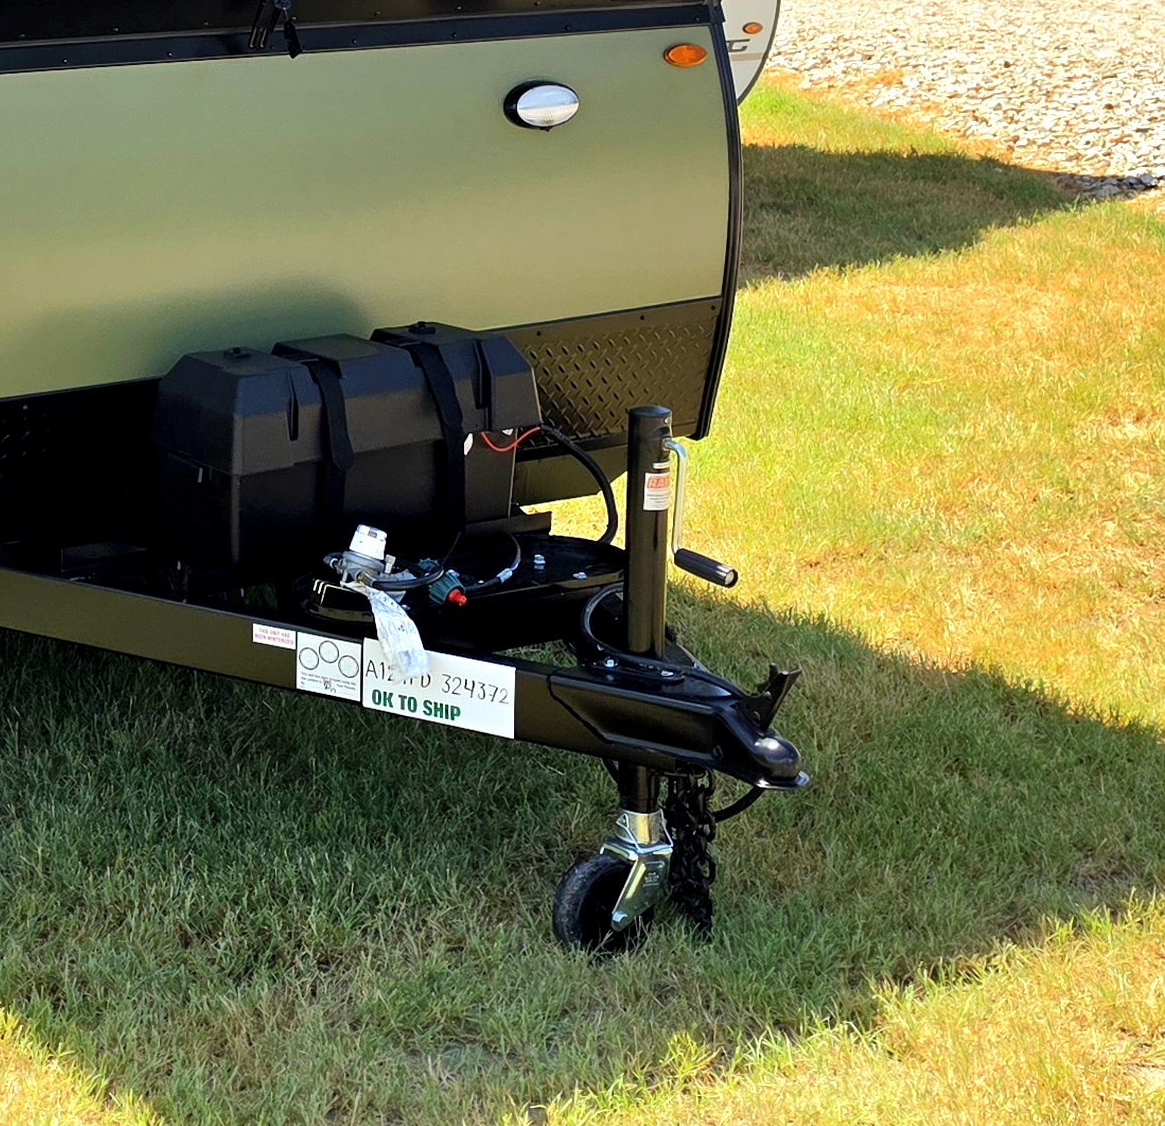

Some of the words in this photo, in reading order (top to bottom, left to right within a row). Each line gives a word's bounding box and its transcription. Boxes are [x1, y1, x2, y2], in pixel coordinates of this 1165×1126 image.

[372, 689, 394, 708] OK
[398, 694, 418, 713] TO
[423, 700, 461, 721] SHIP
[441, 674, 510, 705] 324372
